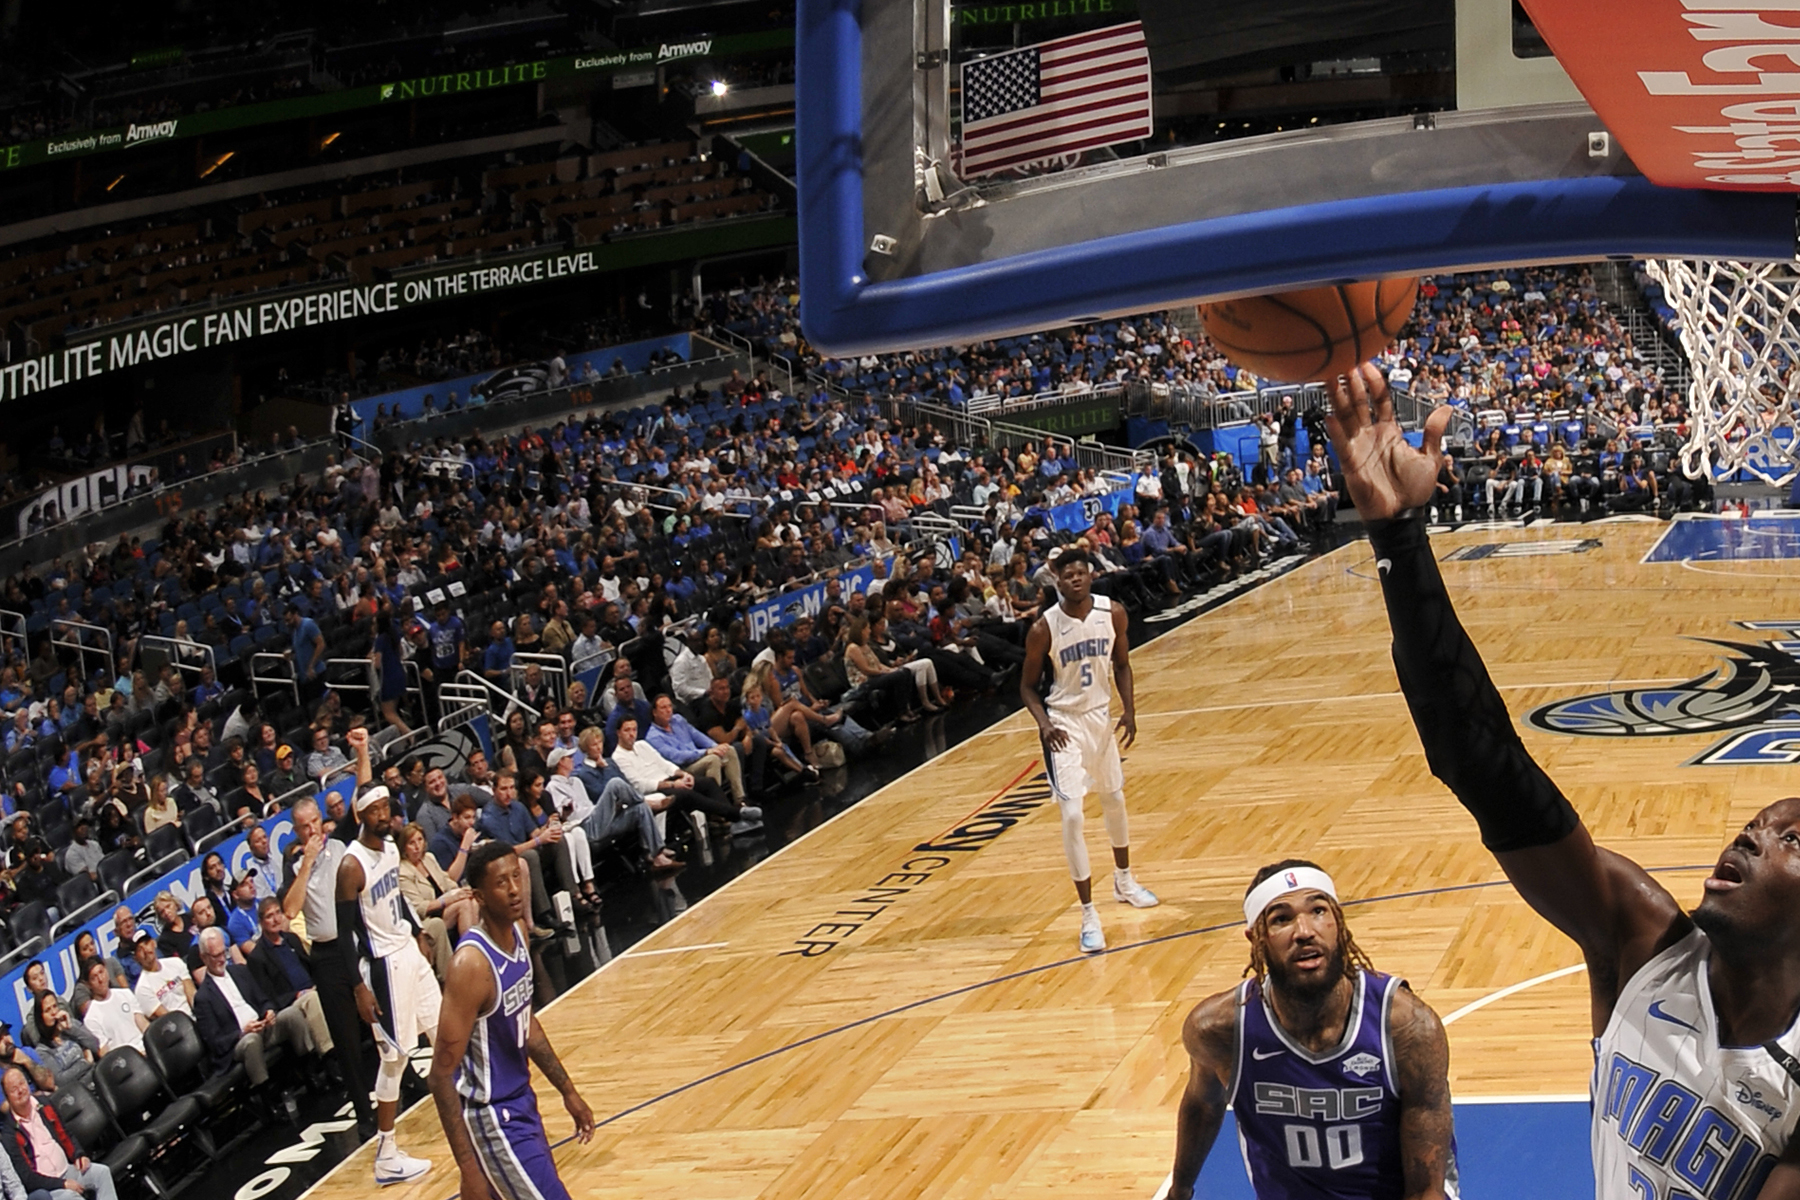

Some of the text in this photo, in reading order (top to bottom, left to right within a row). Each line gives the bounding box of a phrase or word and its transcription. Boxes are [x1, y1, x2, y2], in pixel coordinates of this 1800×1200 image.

[962, 0, 1113, 25] NUTRILITE
[574, 51, 653, 70] Exclusively from
[657, 40, 712, 64] Amway
[400, 61, 547, 99] NUTRILITE
[47, 133, 121, 155] Exclusively from
[125, 119, 178, 148] Amway
[0, 252, 599, 400] TRILITE MAGIC FAN EXPERIENCE ON THE TERRACE LEVEL
[1082, 497, 1103, 521] 30
[1060, 638, 1109, 668] MAGIC
[1081, 663, 1092, 687] 5
[777, 856, 951, 958] CENTER
[1254, 1082, 1384, 1120] SAC
[1285, 1124, 1365, 1170] 00
